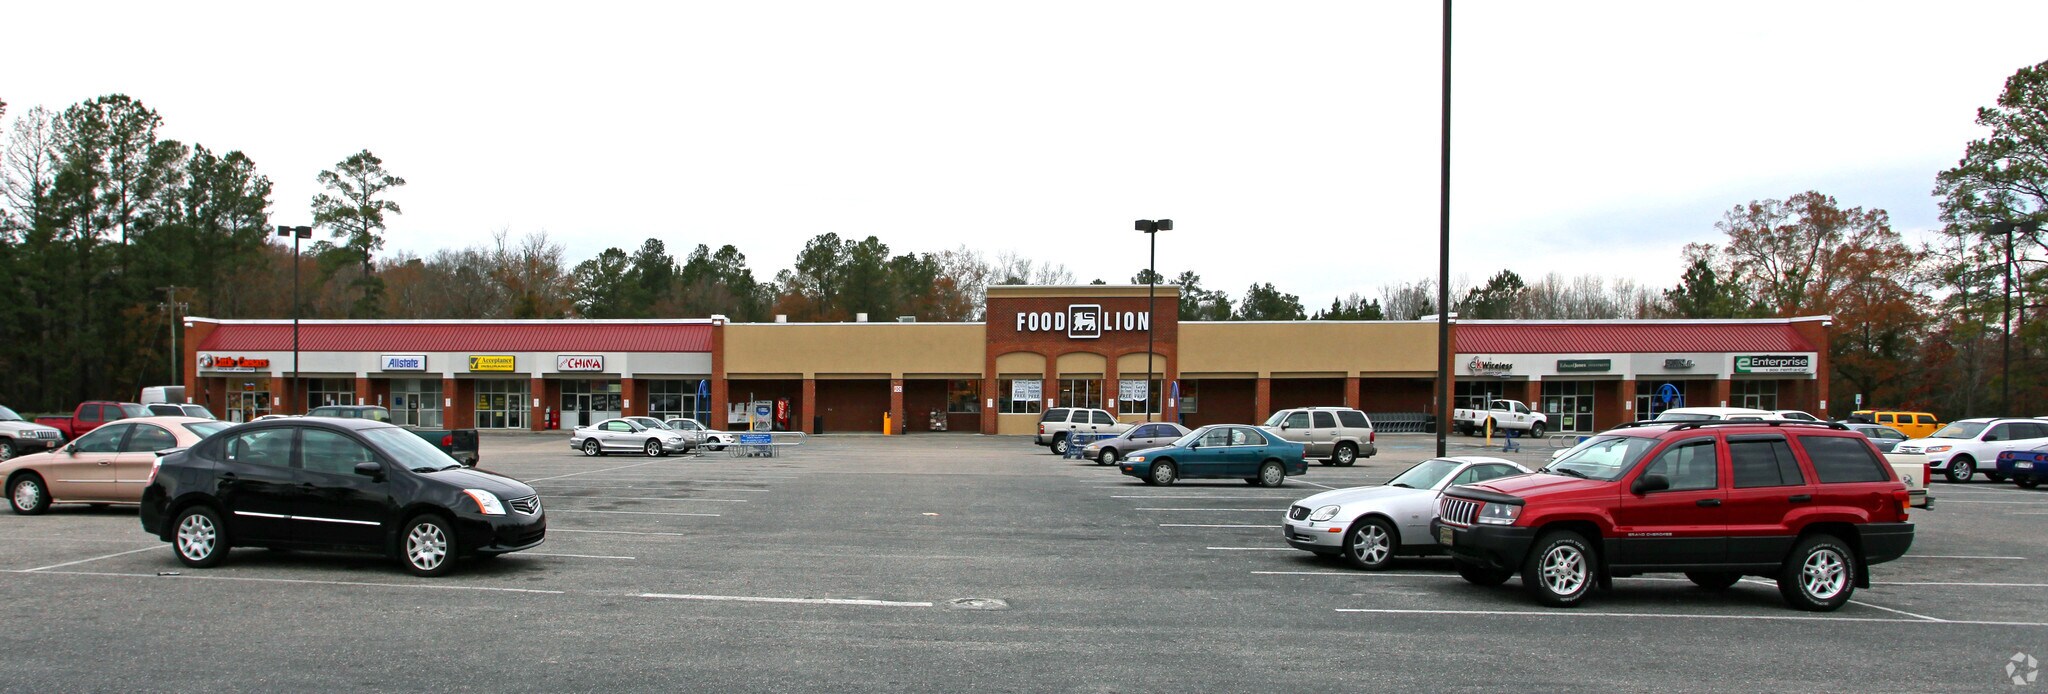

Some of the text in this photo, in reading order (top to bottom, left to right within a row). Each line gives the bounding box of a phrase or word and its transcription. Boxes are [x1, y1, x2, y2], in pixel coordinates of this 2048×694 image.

[1017, 311, 1149, 332] FOOD LION
[214, 356, 269, 368] Little Caesars
[387, 358, 419, 368] Allstate
[567, 358, 601, 369] CHINA
[1752, 357, 1808, 367] Enterprise
